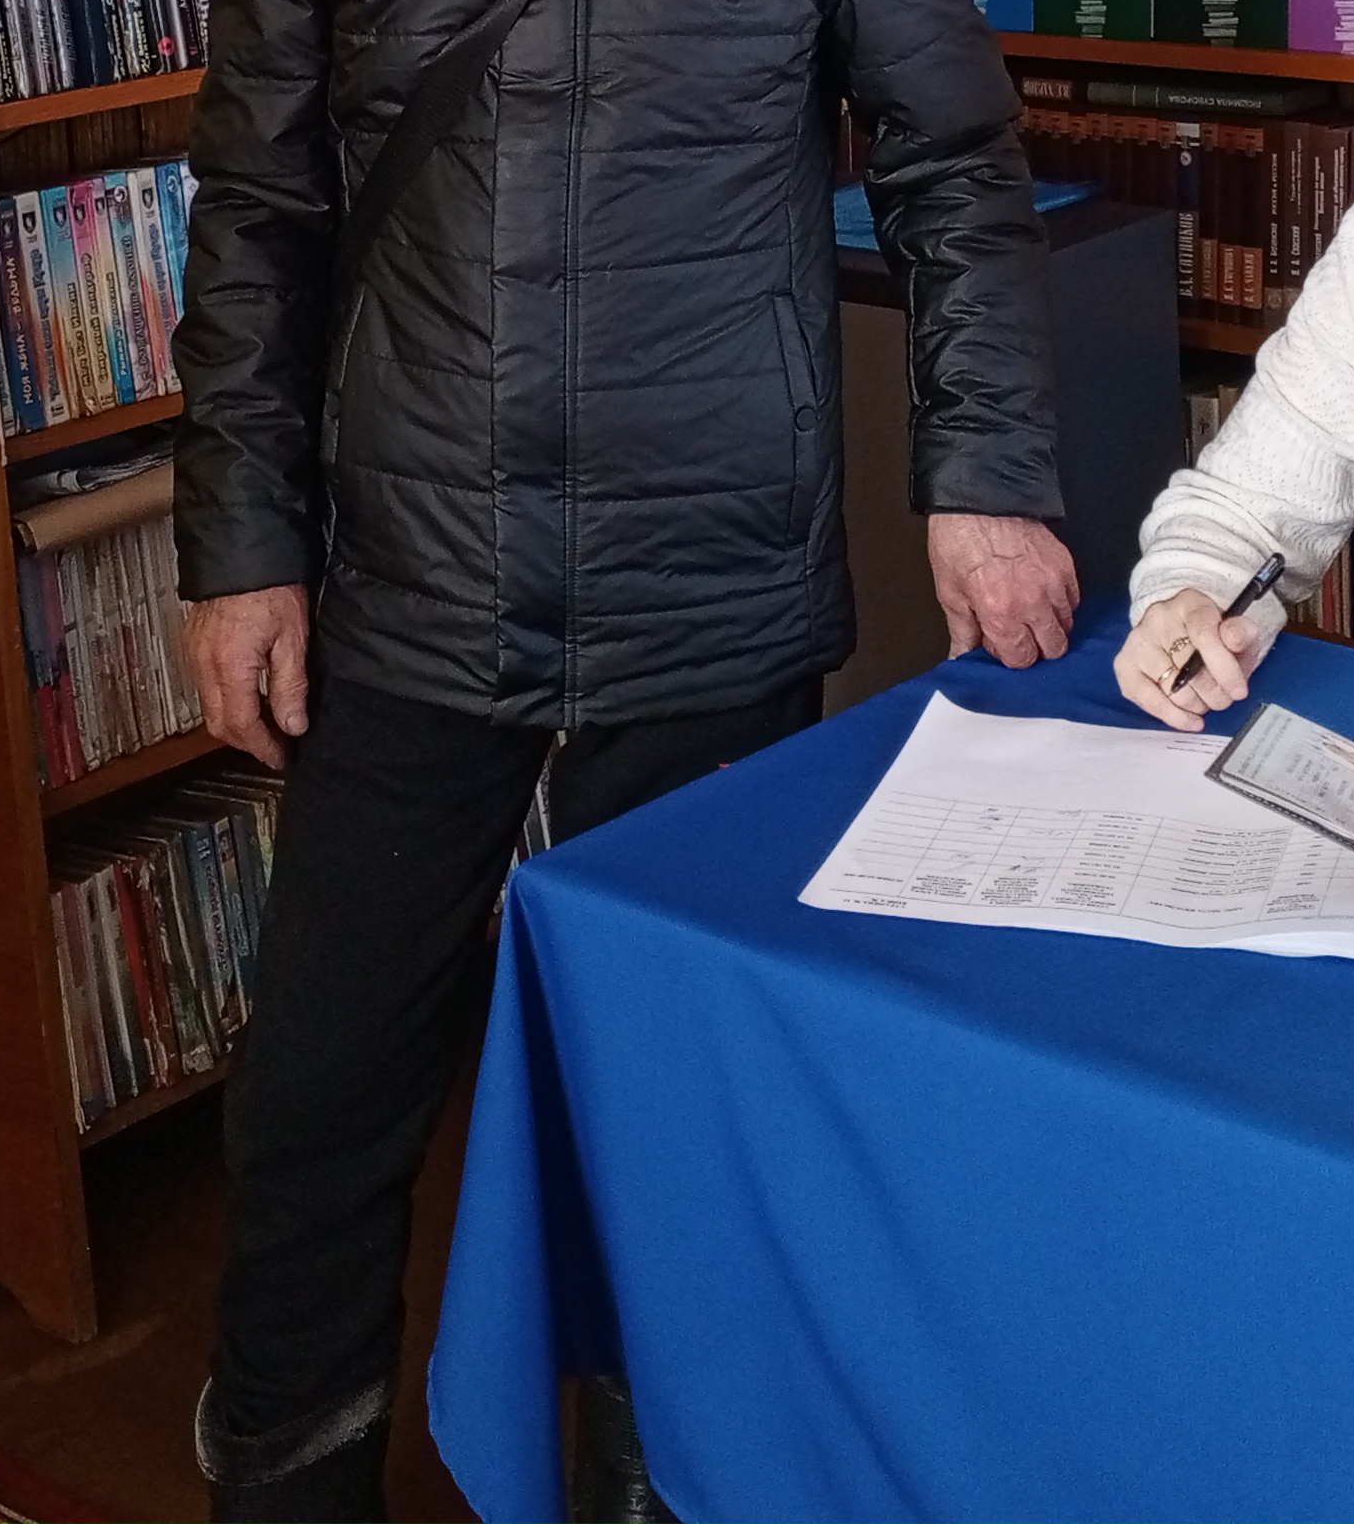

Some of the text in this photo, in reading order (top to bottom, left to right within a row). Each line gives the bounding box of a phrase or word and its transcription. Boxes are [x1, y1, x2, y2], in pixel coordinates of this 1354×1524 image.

[7, 255, 34, 404] МОЯ ЖЕНА ВЕДЬМА
